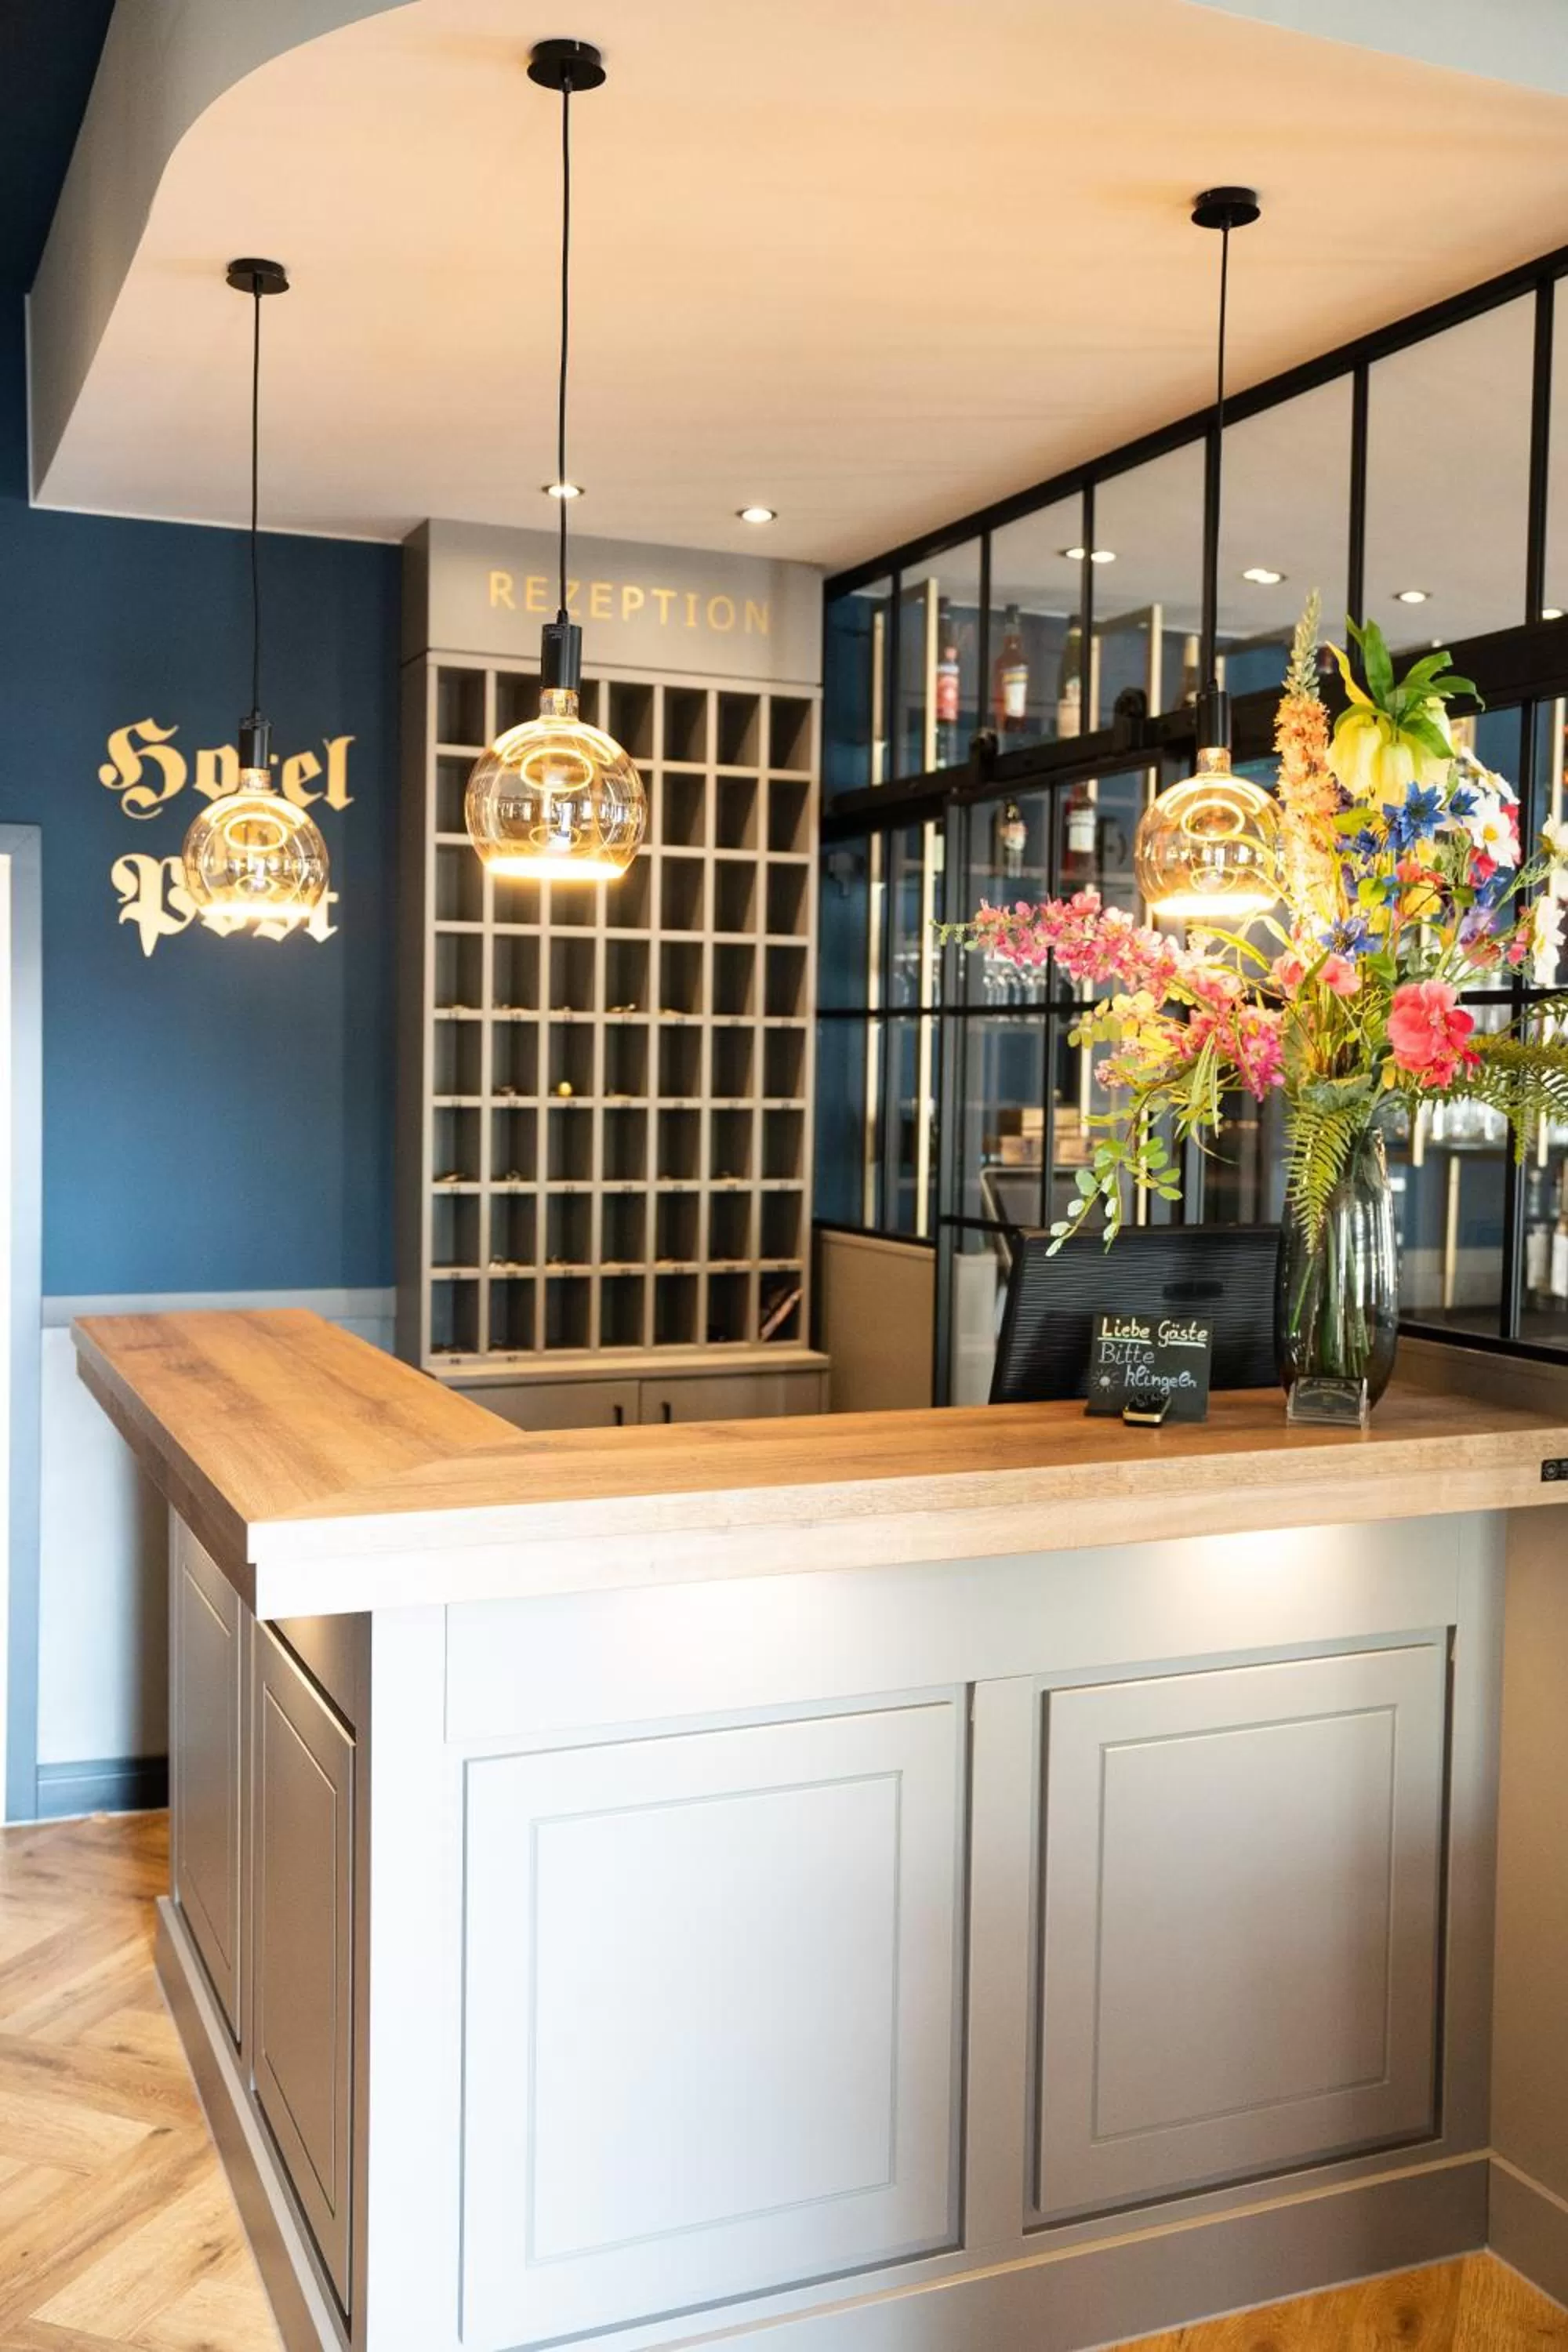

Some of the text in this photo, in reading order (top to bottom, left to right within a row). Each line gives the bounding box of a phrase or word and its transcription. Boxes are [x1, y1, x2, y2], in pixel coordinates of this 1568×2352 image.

[98, 717, 356, 819] Hoel
[1101, 1317, 1209, 1348] Liebe Gäste
[1098, 1341, 1156, 1365] Bitte
